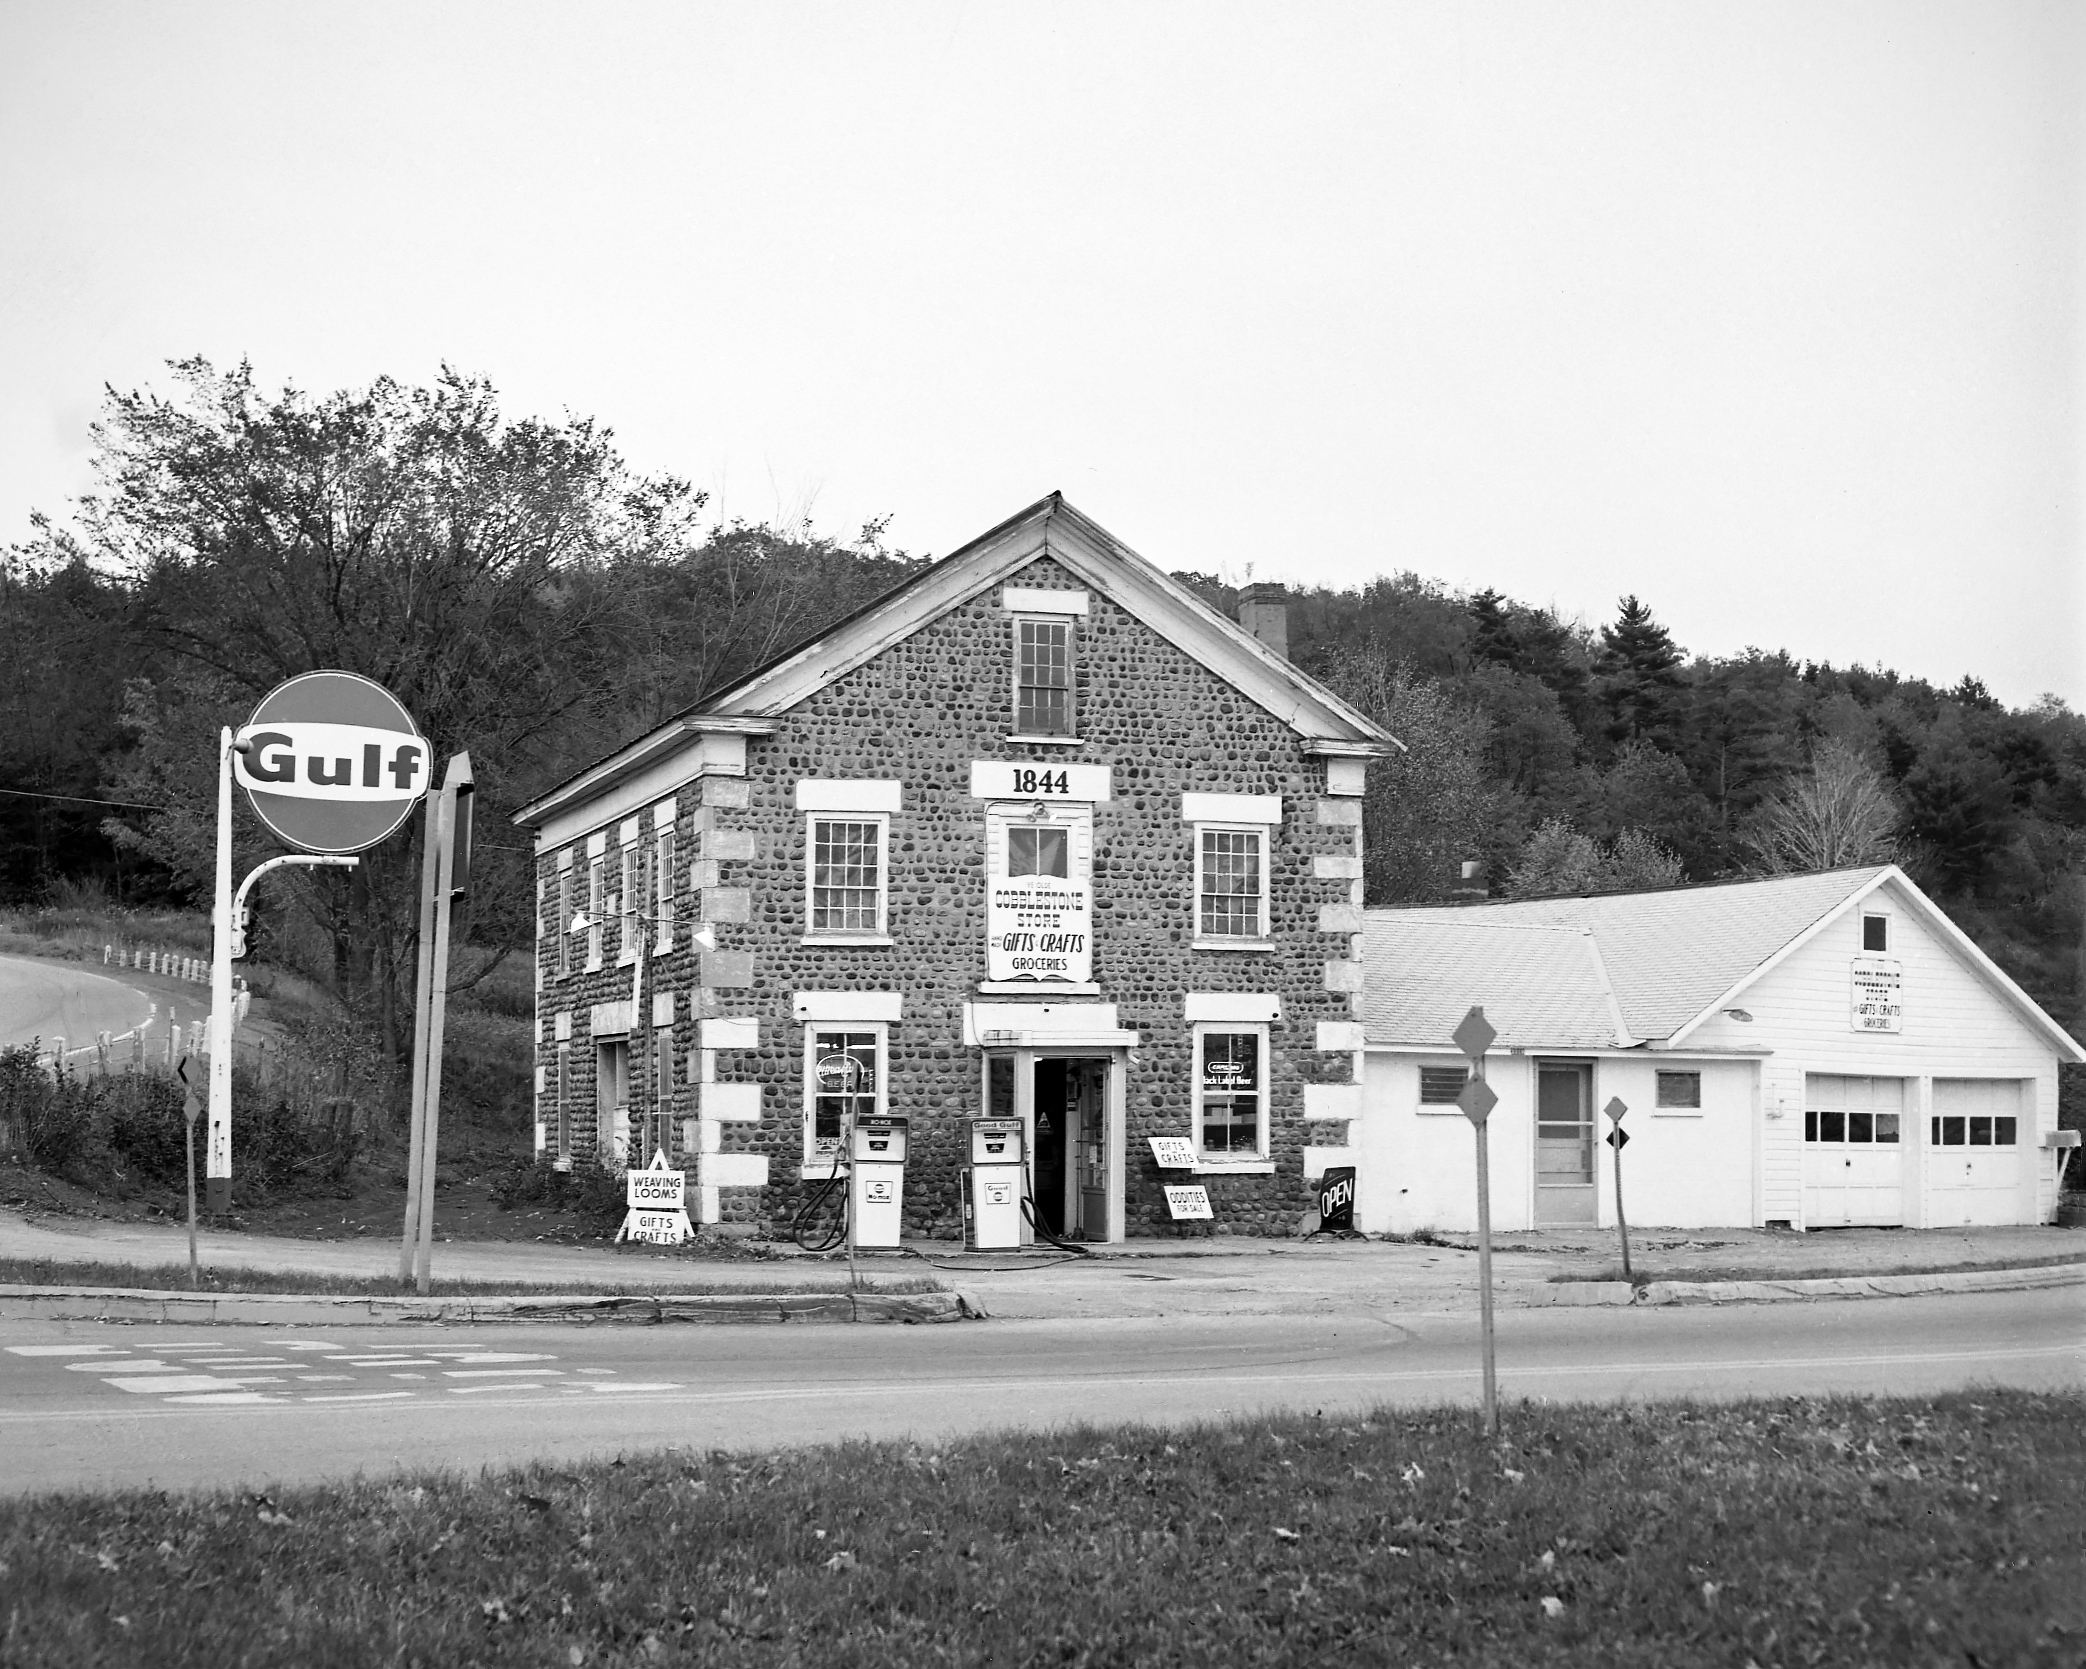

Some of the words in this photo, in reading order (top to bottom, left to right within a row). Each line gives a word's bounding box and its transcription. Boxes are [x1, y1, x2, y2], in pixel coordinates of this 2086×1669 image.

[243, 732, 421, 789] Gulf
[1013, 768, 1069, 794] 1844
[996, 890, 1083, 910] COBBLESTONE
[1017, 913, 1060, 928] STORE
[1003, 932, 1036, 952] GIFTS
[1040, 933, 1085, 953] CRAFTS
[1012, 957, 1068, 970] GROCERIES
[1859, 1003, 1876, 1015] GIFTS
[1880, 1004, 1901, 1017] CRAFTS
[1203, 1075, 1217, 1084] lack
[1158, 1141, 1185, 1151] GIFTS
[1161, 1153, 1195, 1163] CRAFTS
[634, 1176, 681, 1188] WEAVING
[634, 1188, 677, 1199] LOOMS
[1170, 1191, 1205, 1204] ODDITIES
[1322, 1177, 1353, 1218] OPEN
[639, 1216, 673, 1229] GIFTS
[633, 1230, 677, 1244] CRAFTS
